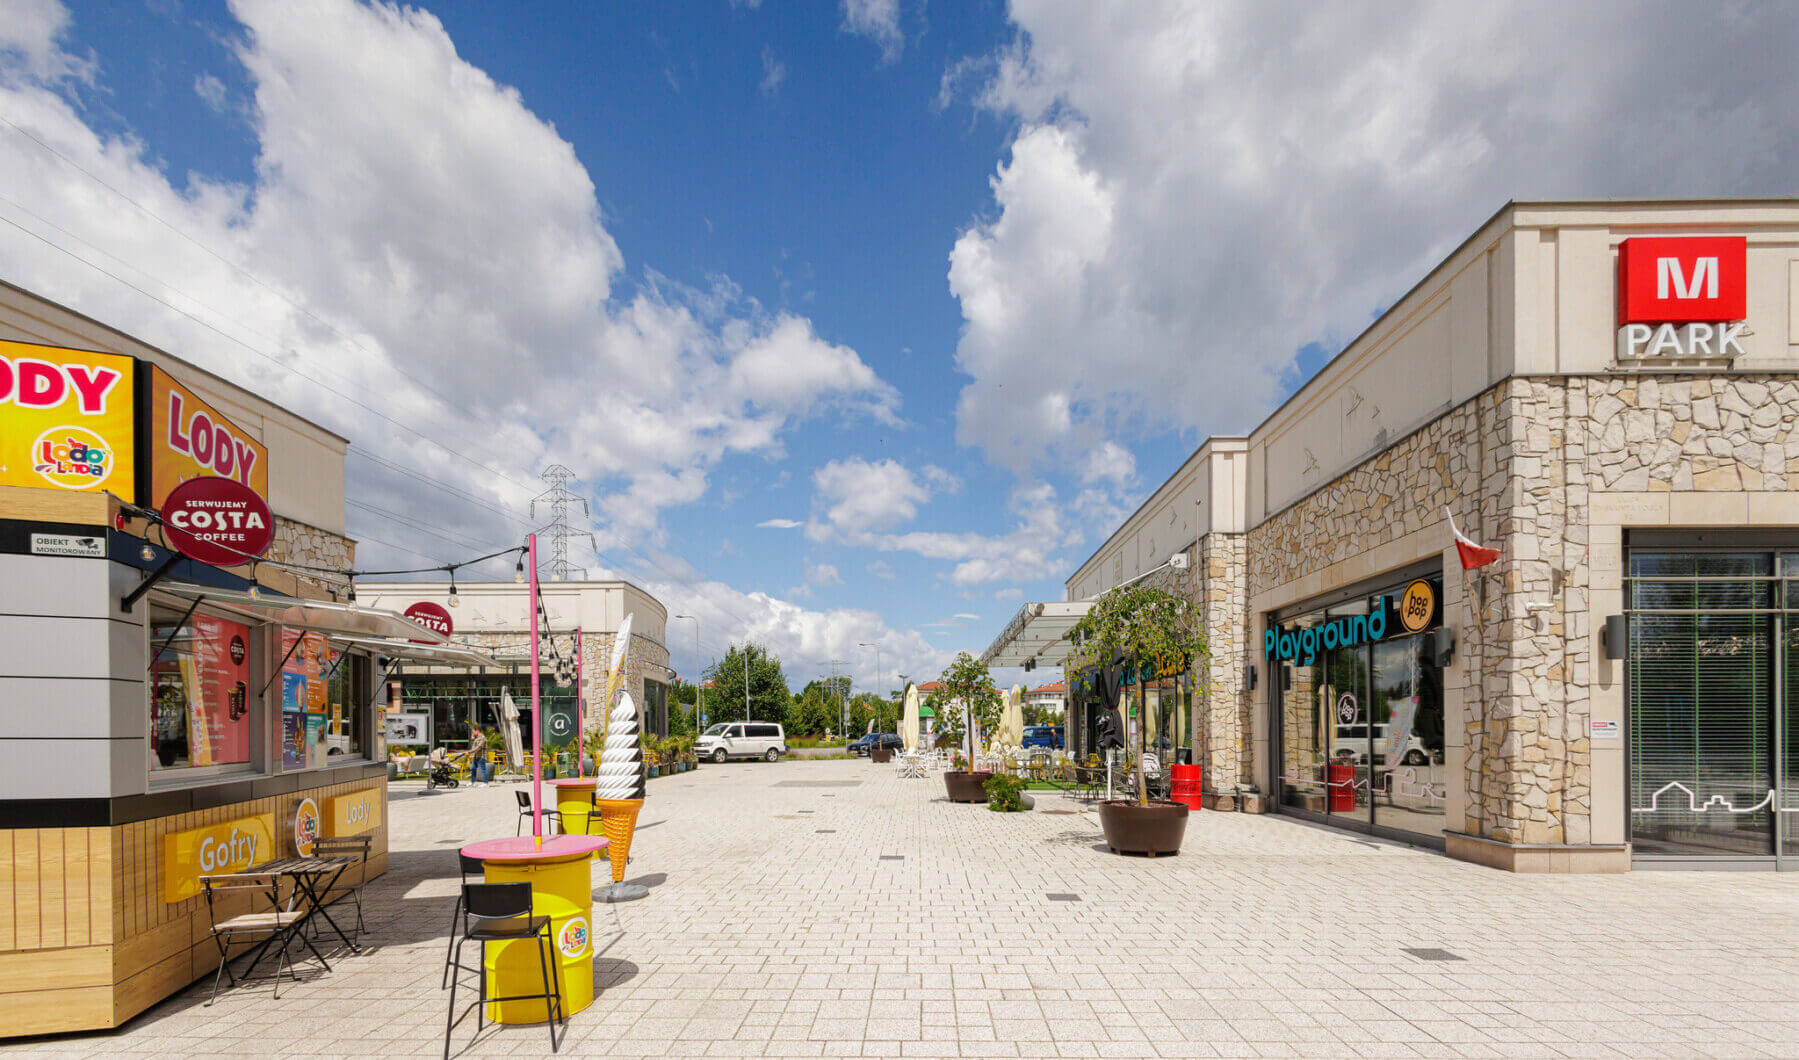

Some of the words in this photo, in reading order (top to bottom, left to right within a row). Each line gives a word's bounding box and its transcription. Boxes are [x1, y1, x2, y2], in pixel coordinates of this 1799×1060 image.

[1656, 256, 1719, 299] M
[1627, 322, 1747, 355] PARK
[0, 355, 122, 415] DY
[169, 389, 257, 487] LODY
[185, 500, 247, 509] SERWUJEMY
[171, 510, 265, 531] COSTA
[36, 537, 69, 546] OBIEKT
[194, 532, 246, 542] COFFEE
[36, 546, 102, 555] MONITOROWANY
[1410, 591, 1428, 607] hop
[1407, 606, 1427, 620] pop
[1264, 595, 1386, 667] Playground
[346, 797, 370, 826] Lody
[200, 828, 257, 871] Gofry
